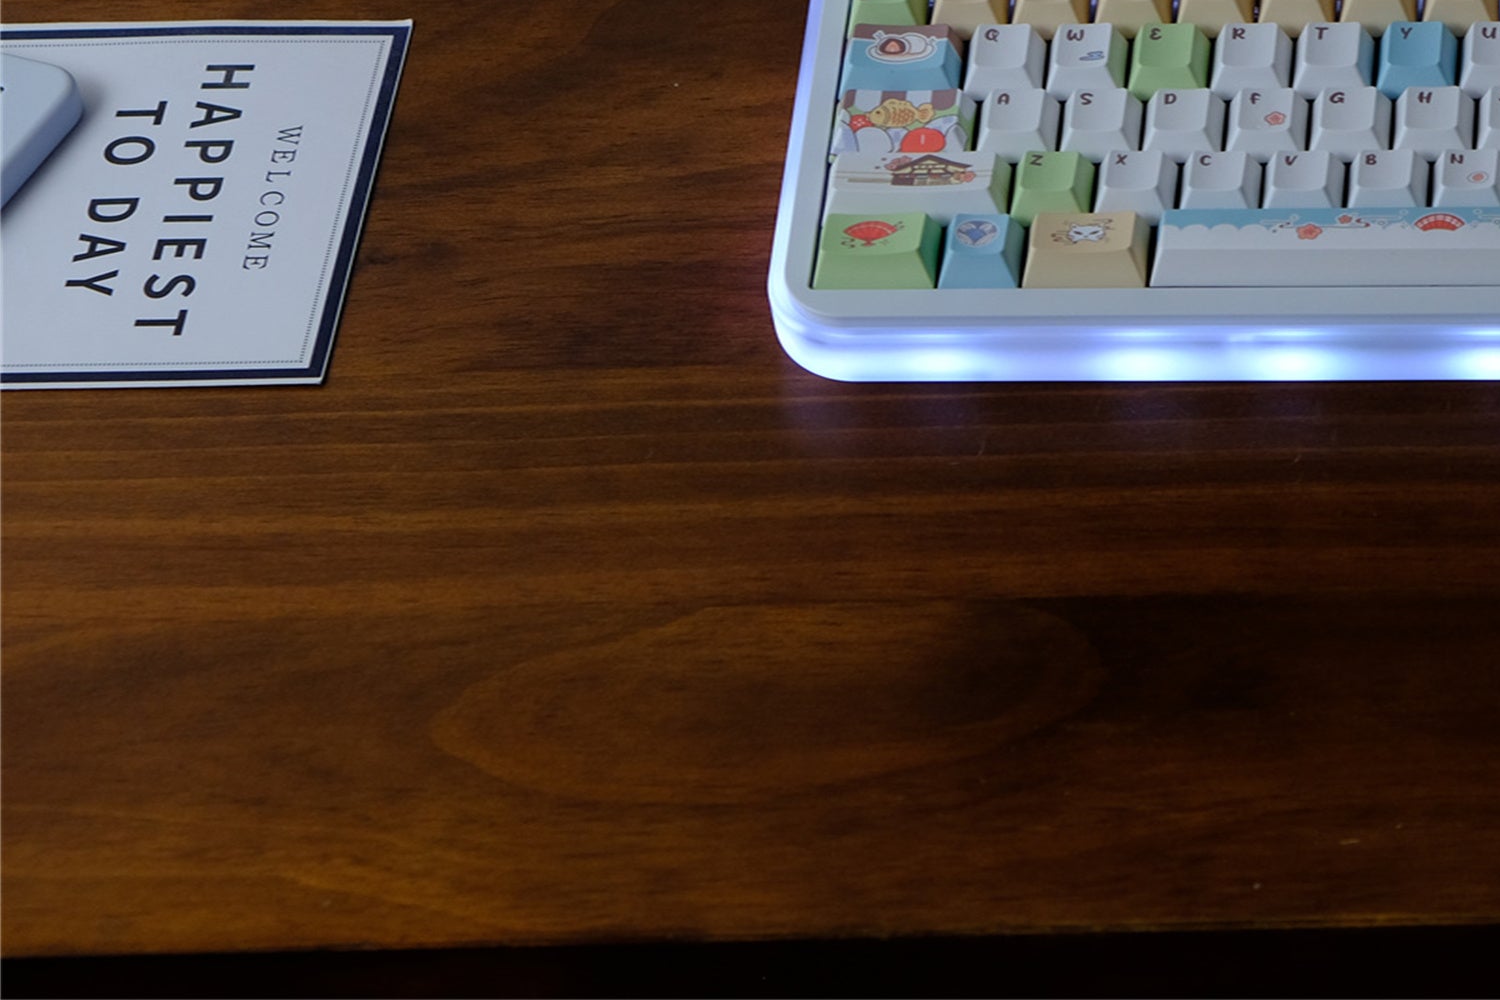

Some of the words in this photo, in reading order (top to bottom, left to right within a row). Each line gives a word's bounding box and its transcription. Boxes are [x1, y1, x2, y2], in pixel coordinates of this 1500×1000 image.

[984, 28, 1000, 43] Q
[1066, 28, 1085, 42] W
[1149, 27, 1162, 41] E
[1231, 27, 1246, 40] R
[1314, 26, 1329, 41] T
[1400, 26, 1413, 40] Y
[1481, 26, 1497, 40] U
[996, 92, 1010, 105] A
[1079, 92, 1094, 106] S
[1163, 92, 1177, 105] D
[1249, 92, 1261, 105] F
[1329, 91, 1345, 104] G
[1417, 91, 1433, 104] H
[103, 100, 168, 166] TO
[1029, 154, 1044, 167] Z
[1115, 153, 1128, 166] X
[1199, 154, 1212, 167] C
[1284, 155, 1298, 167] V
[1365, 153, 1377, 166] B
[1449, 153, 1464, 165] N
[133, 64, 256, 336] HAPPIEST
[242, 125, 304, 270] WELCOME
[64, 197, 141, 297] DAY
